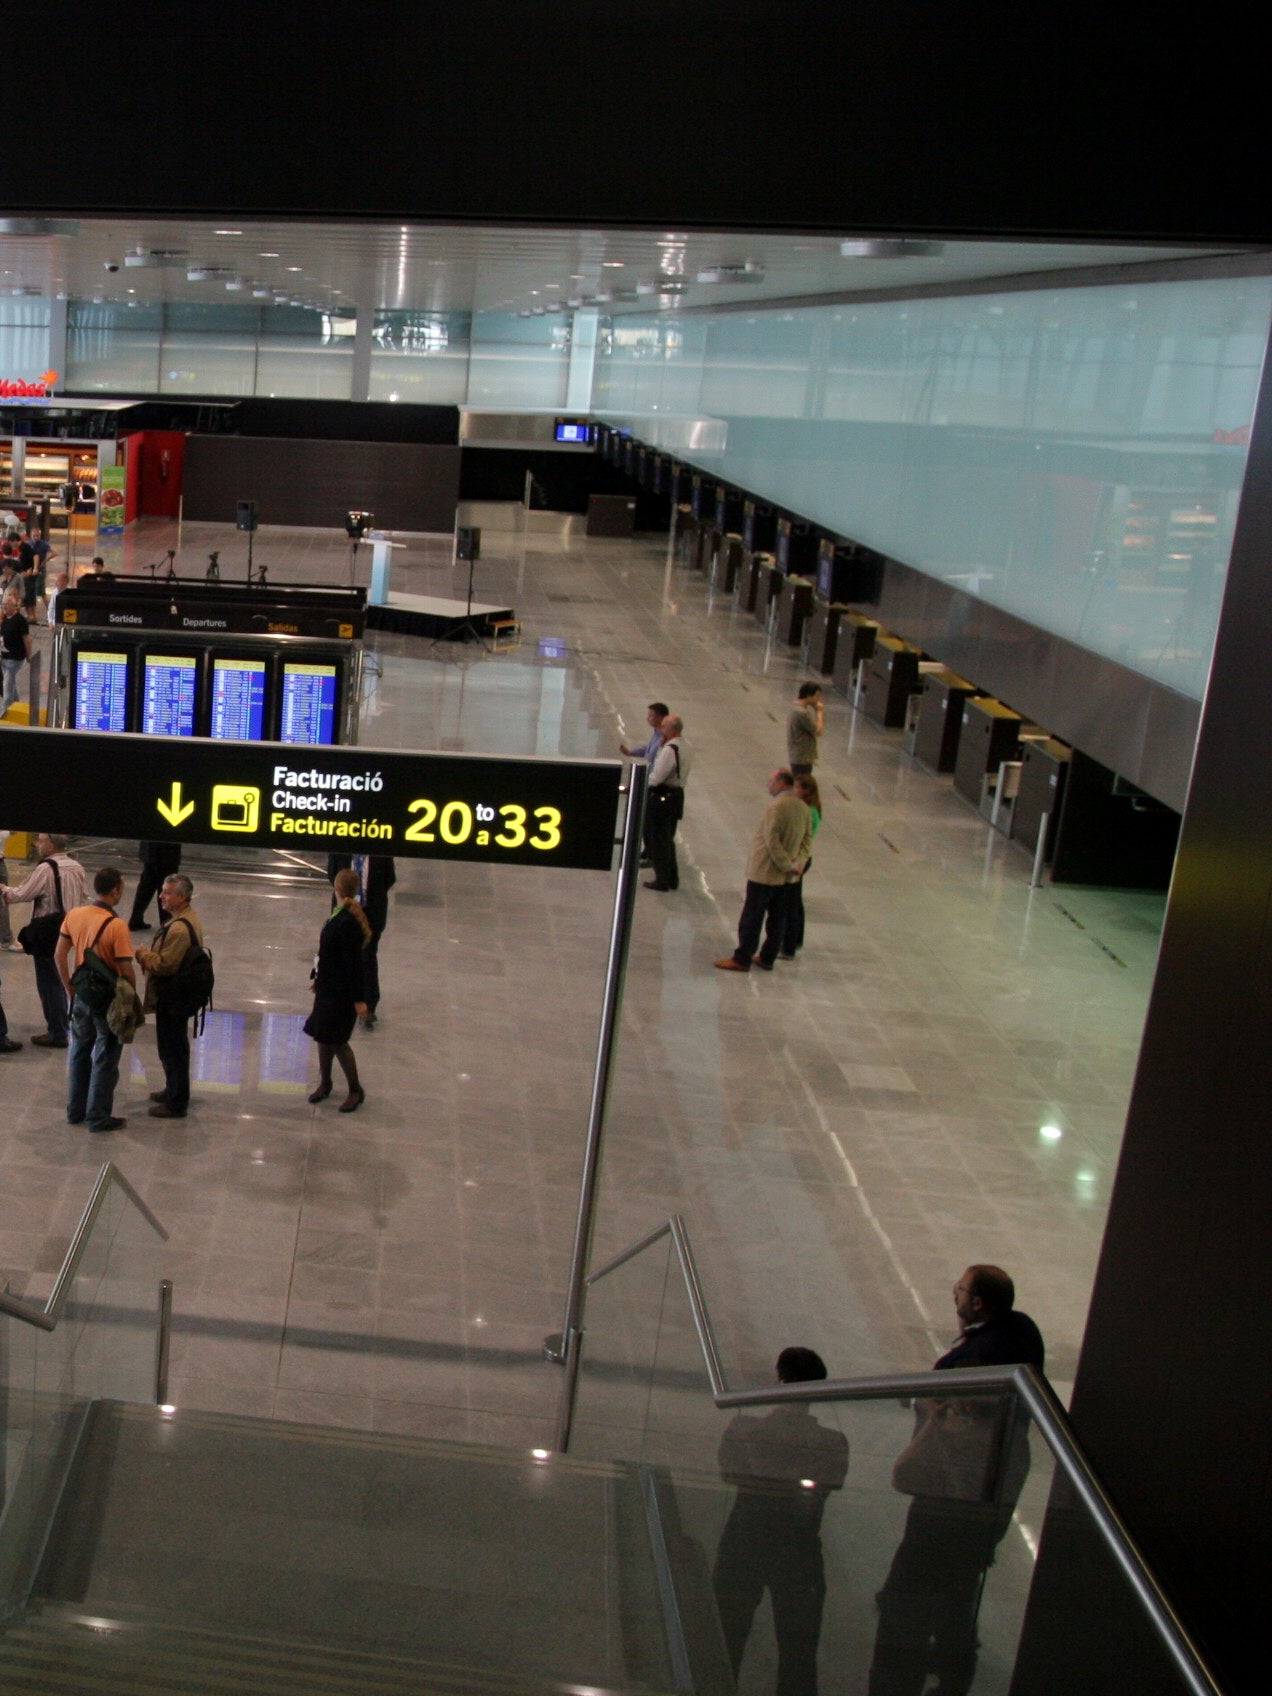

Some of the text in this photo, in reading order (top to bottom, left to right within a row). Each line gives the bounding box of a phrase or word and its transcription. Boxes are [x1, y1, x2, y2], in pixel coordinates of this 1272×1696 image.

[109, 614, 143, 624] Sortides
[183, 617, 227, 629] Departures
[267, 622, 299, 633] Salidas
[272, 766, 384, 793] Facturació
[271, 791, 351, 814] Check-in
[270, 813, 393, 840] Facturación
[404, 798, 562, 850] 20 to 33
[476, 830, 489, 846] a
